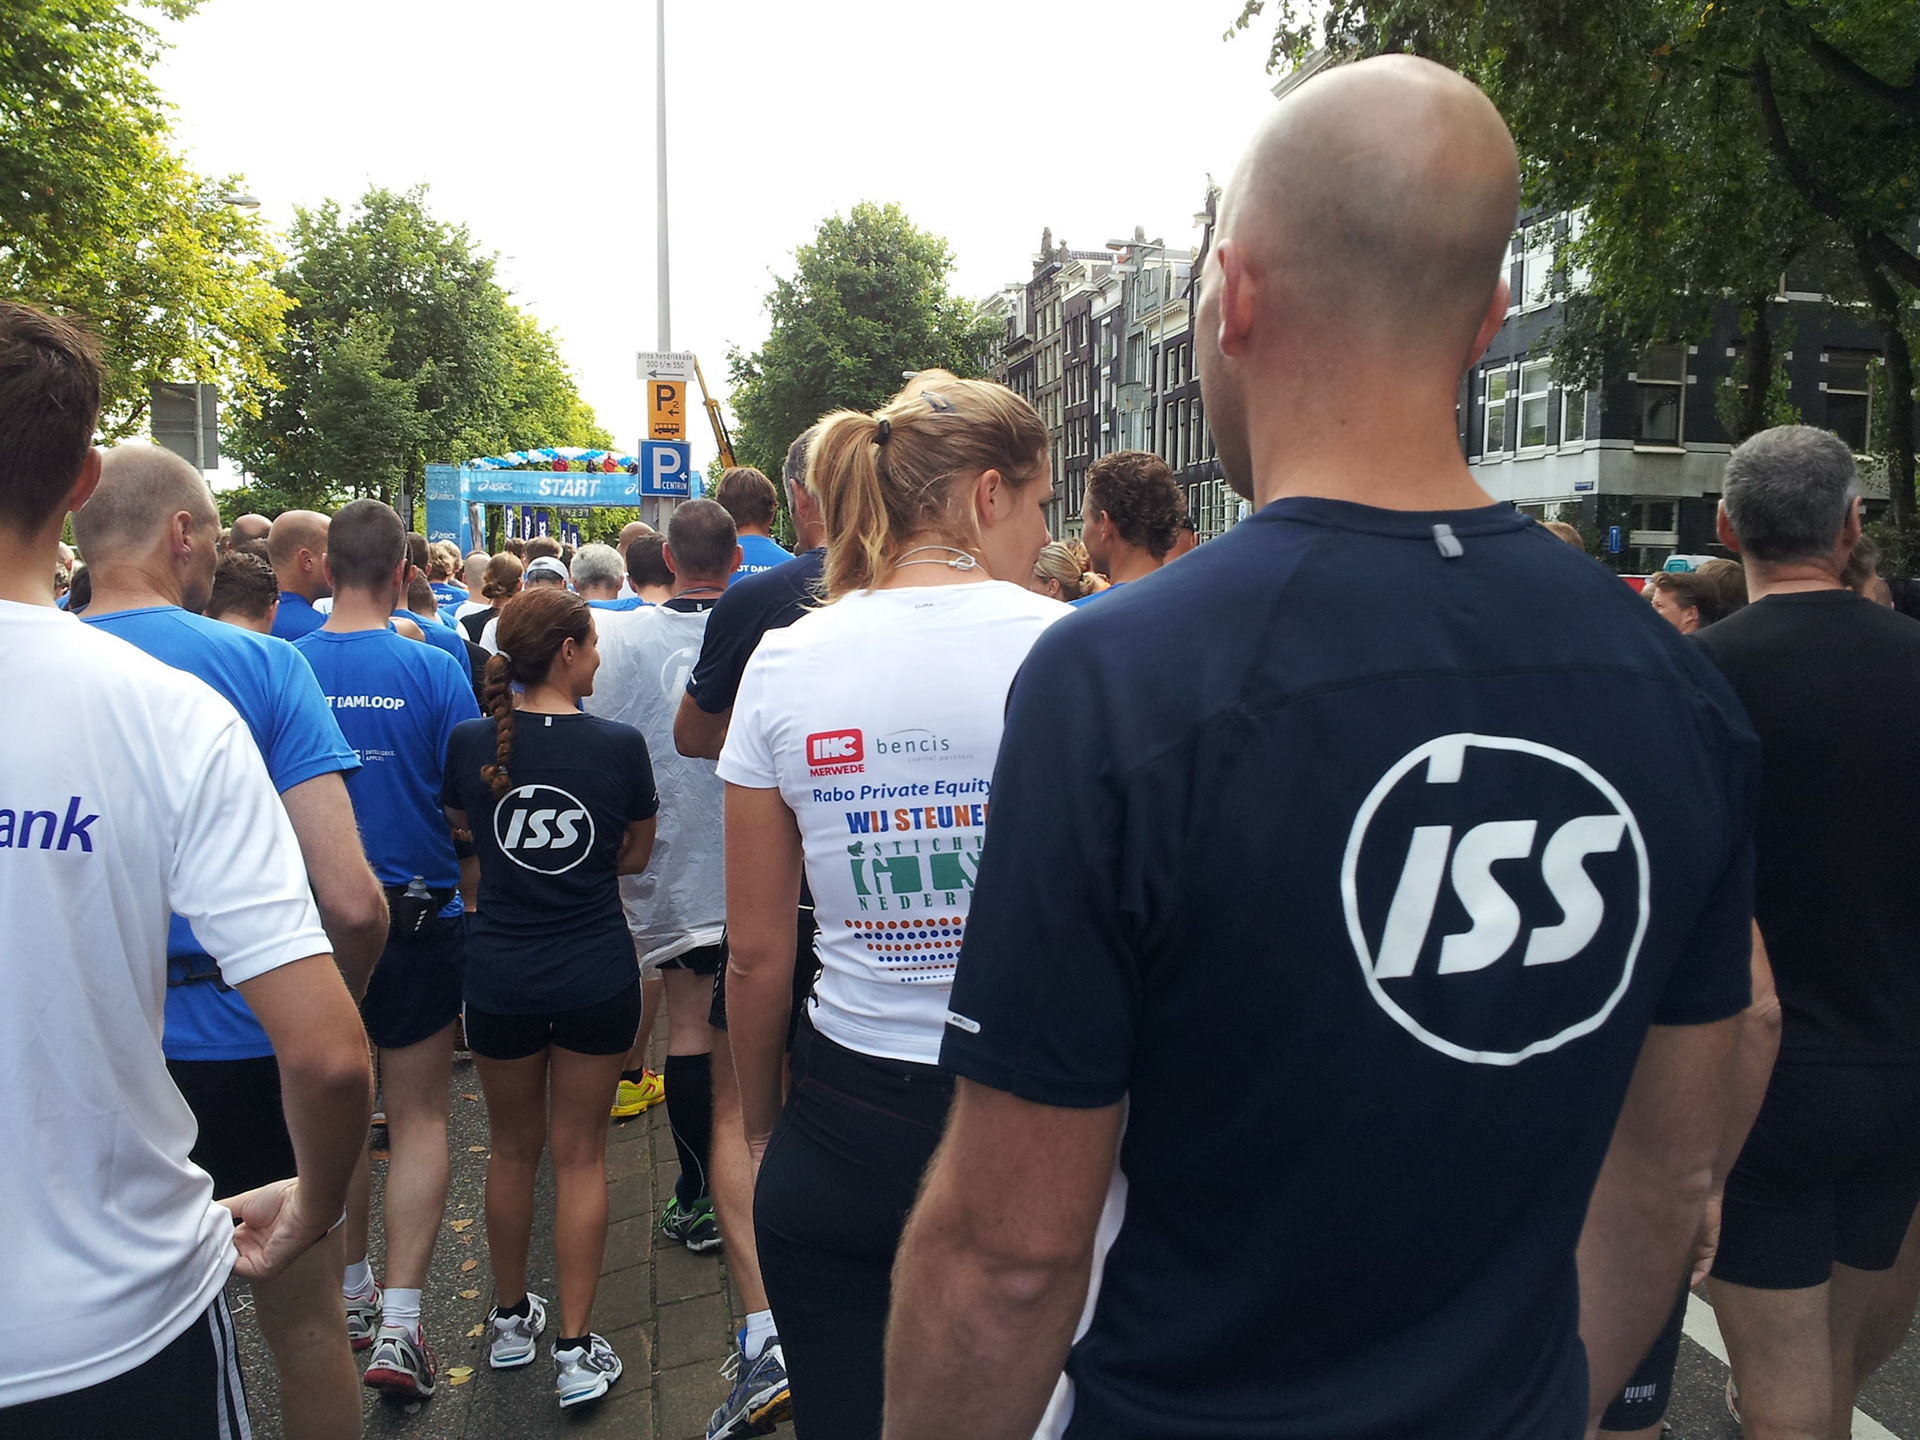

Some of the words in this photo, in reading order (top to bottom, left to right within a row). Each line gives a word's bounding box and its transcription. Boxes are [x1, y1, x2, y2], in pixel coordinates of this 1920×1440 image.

[638, 352, 654, 360] prins
[538, 478, 601, 497] START
[337, 695, 406, 711] DAMLOOP
[813, 735, 857, 761] IHC
[876, 735, 951, 755] bencis
[810, 763, 865, 778] MERWEDE
[813, 786, 855, 803] Rabo
[860, 782, 930, 801] Private
[934, 777, 992, 798] Equity
[845, 809, 889, 835] WIJ
